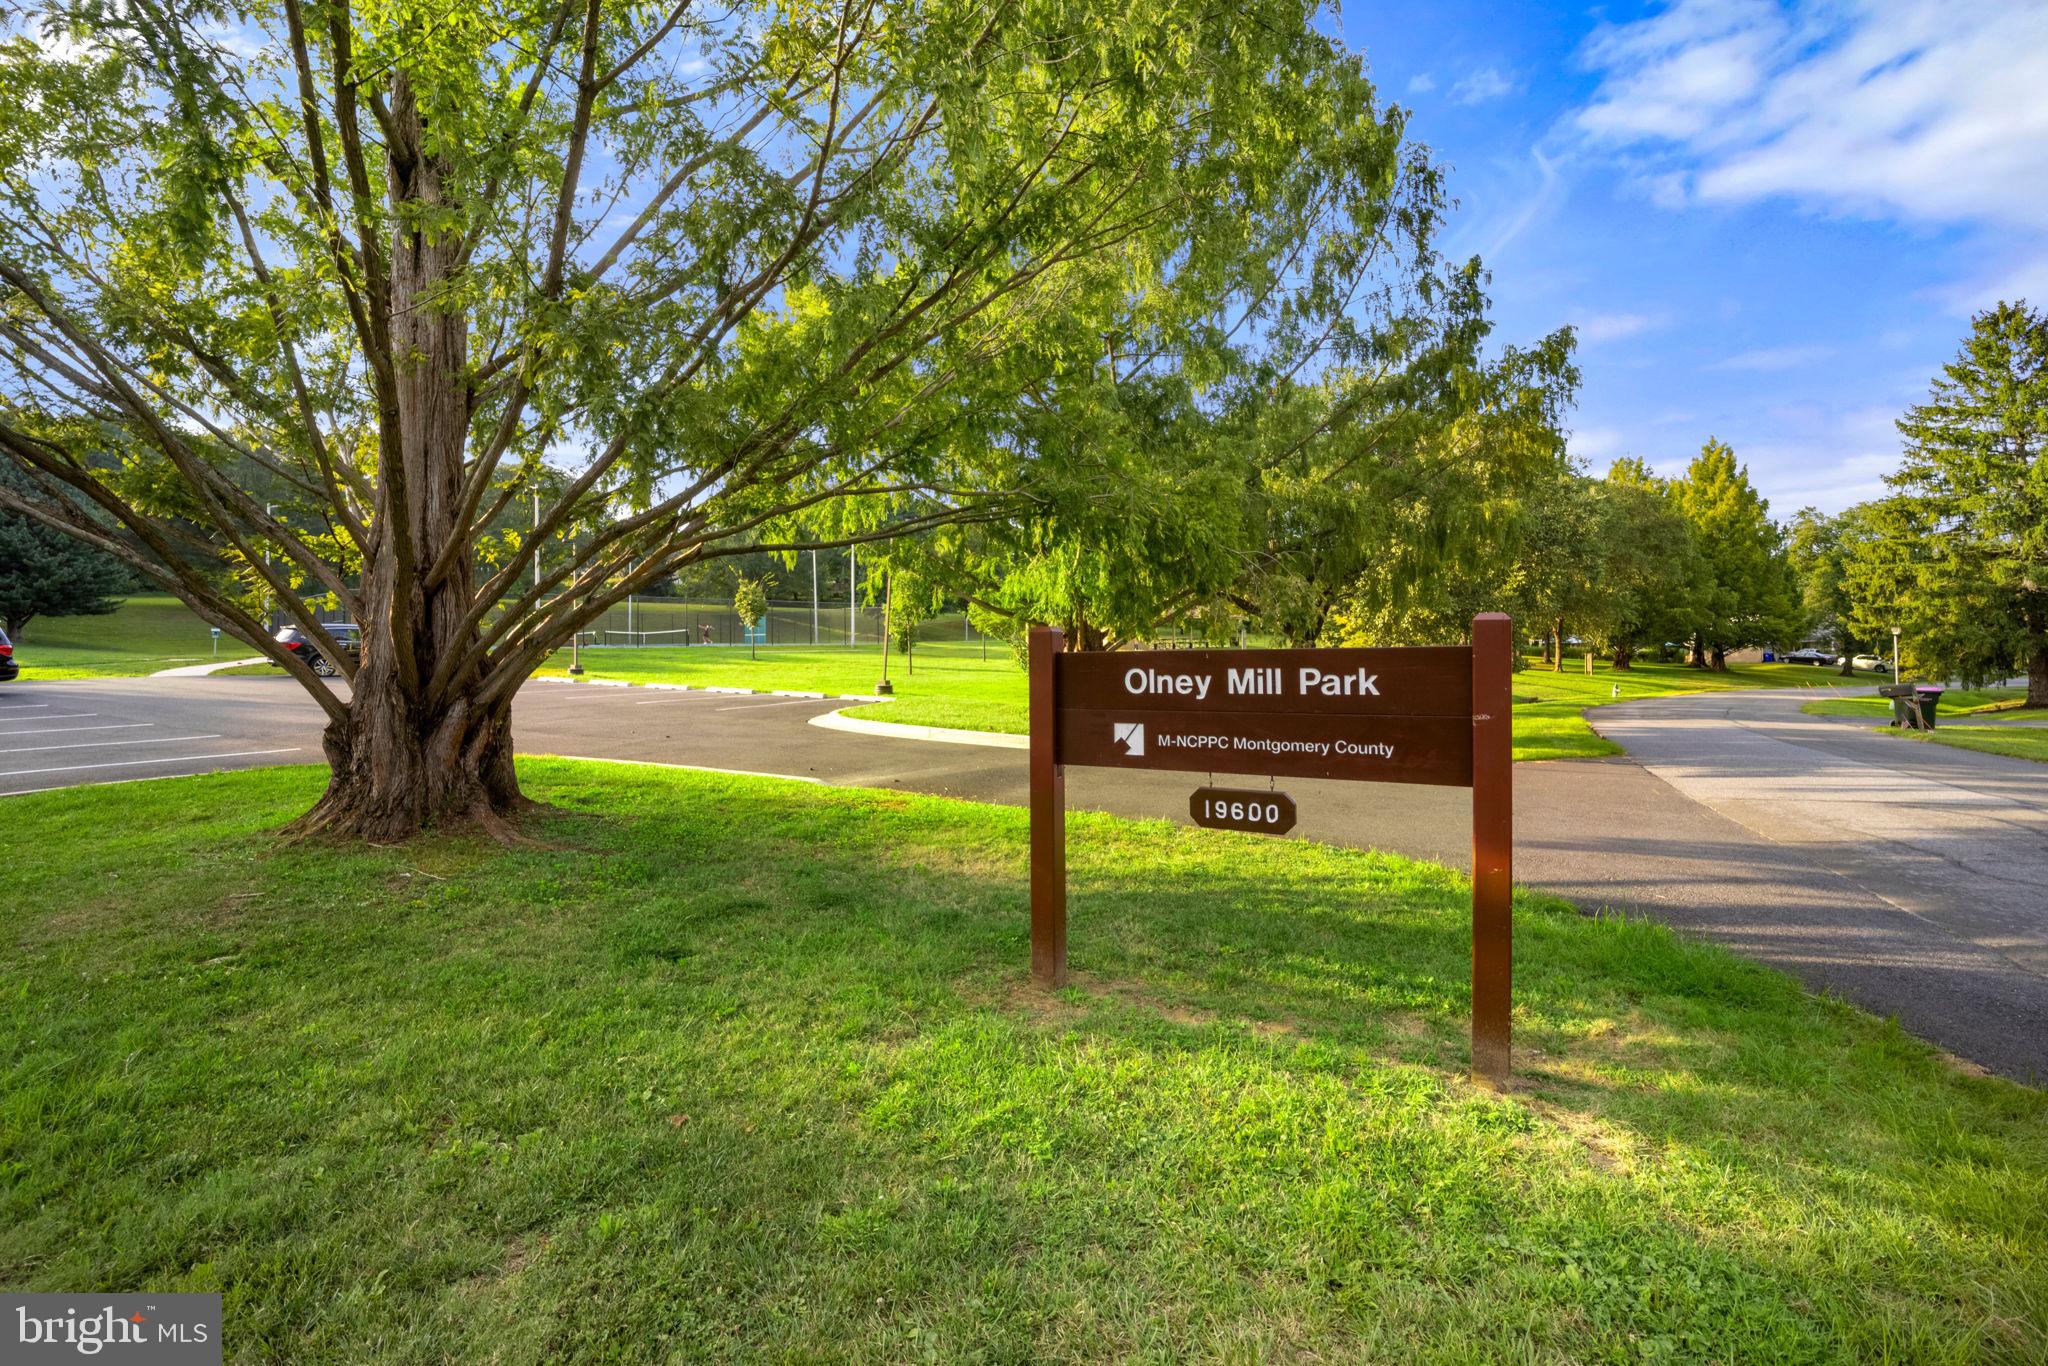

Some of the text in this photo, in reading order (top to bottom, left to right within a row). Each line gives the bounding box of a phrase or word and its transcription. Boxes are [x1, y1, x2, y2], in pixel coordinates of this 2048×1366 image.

[1124, 667, 1380, 699] Olney Mill Park
[1158, 734, 1395, 759] M-NCPPC Montgomery County
[1204, 799, 1280, 824] 19600
